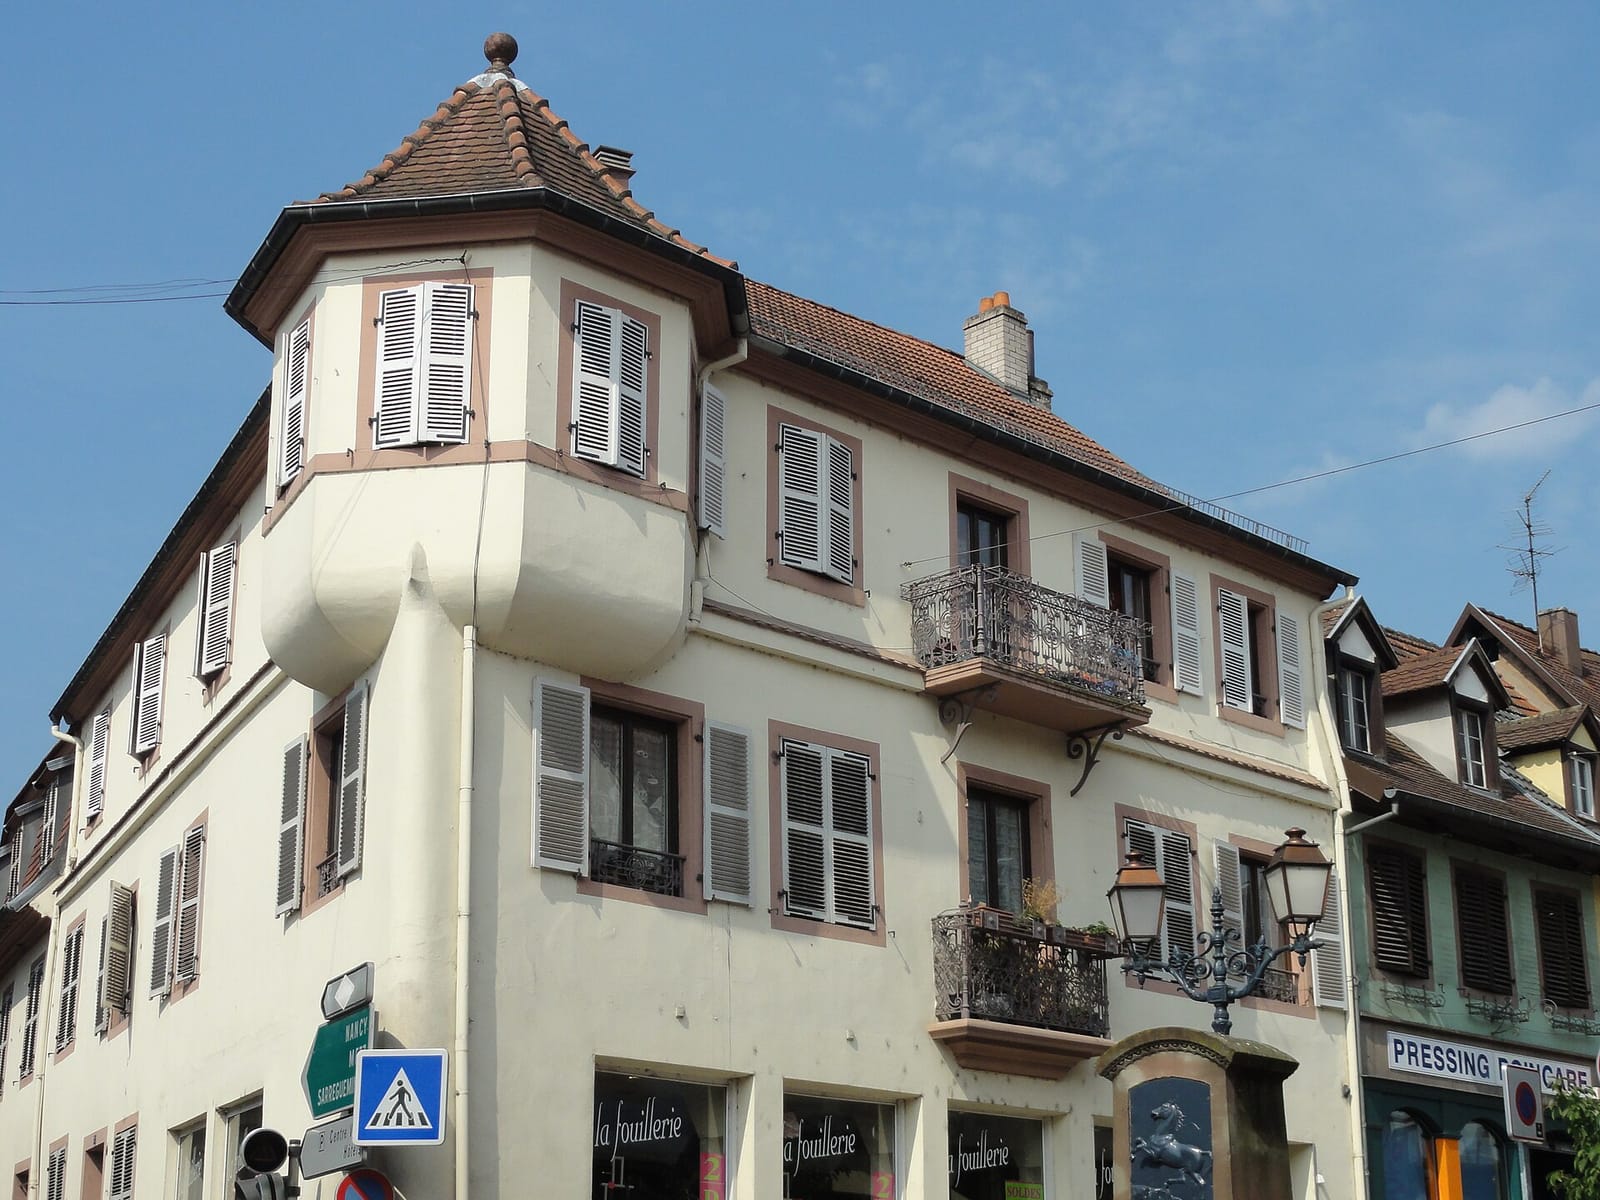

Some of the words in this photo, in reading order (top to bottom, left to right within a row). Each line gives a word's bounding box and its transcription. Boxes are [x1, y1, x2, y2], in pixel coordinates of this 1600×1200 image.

[345, 1016, 368, 1043] NANCY
[1393, 1038, 1490, 1079] PRESSING
[1498, 1057, 1587, 1092] PCARE
[594, 1101, 610, 1147] la
[610, 1096, 682, 1162] fouillerie
[793, 1115, 856, 1177] fouillerie
[704, 1156, 720, 1181] 2
[954, 1129, 1009, 1188] fouillerie
[1007, 1187, 1041, 1199] SOLDES
